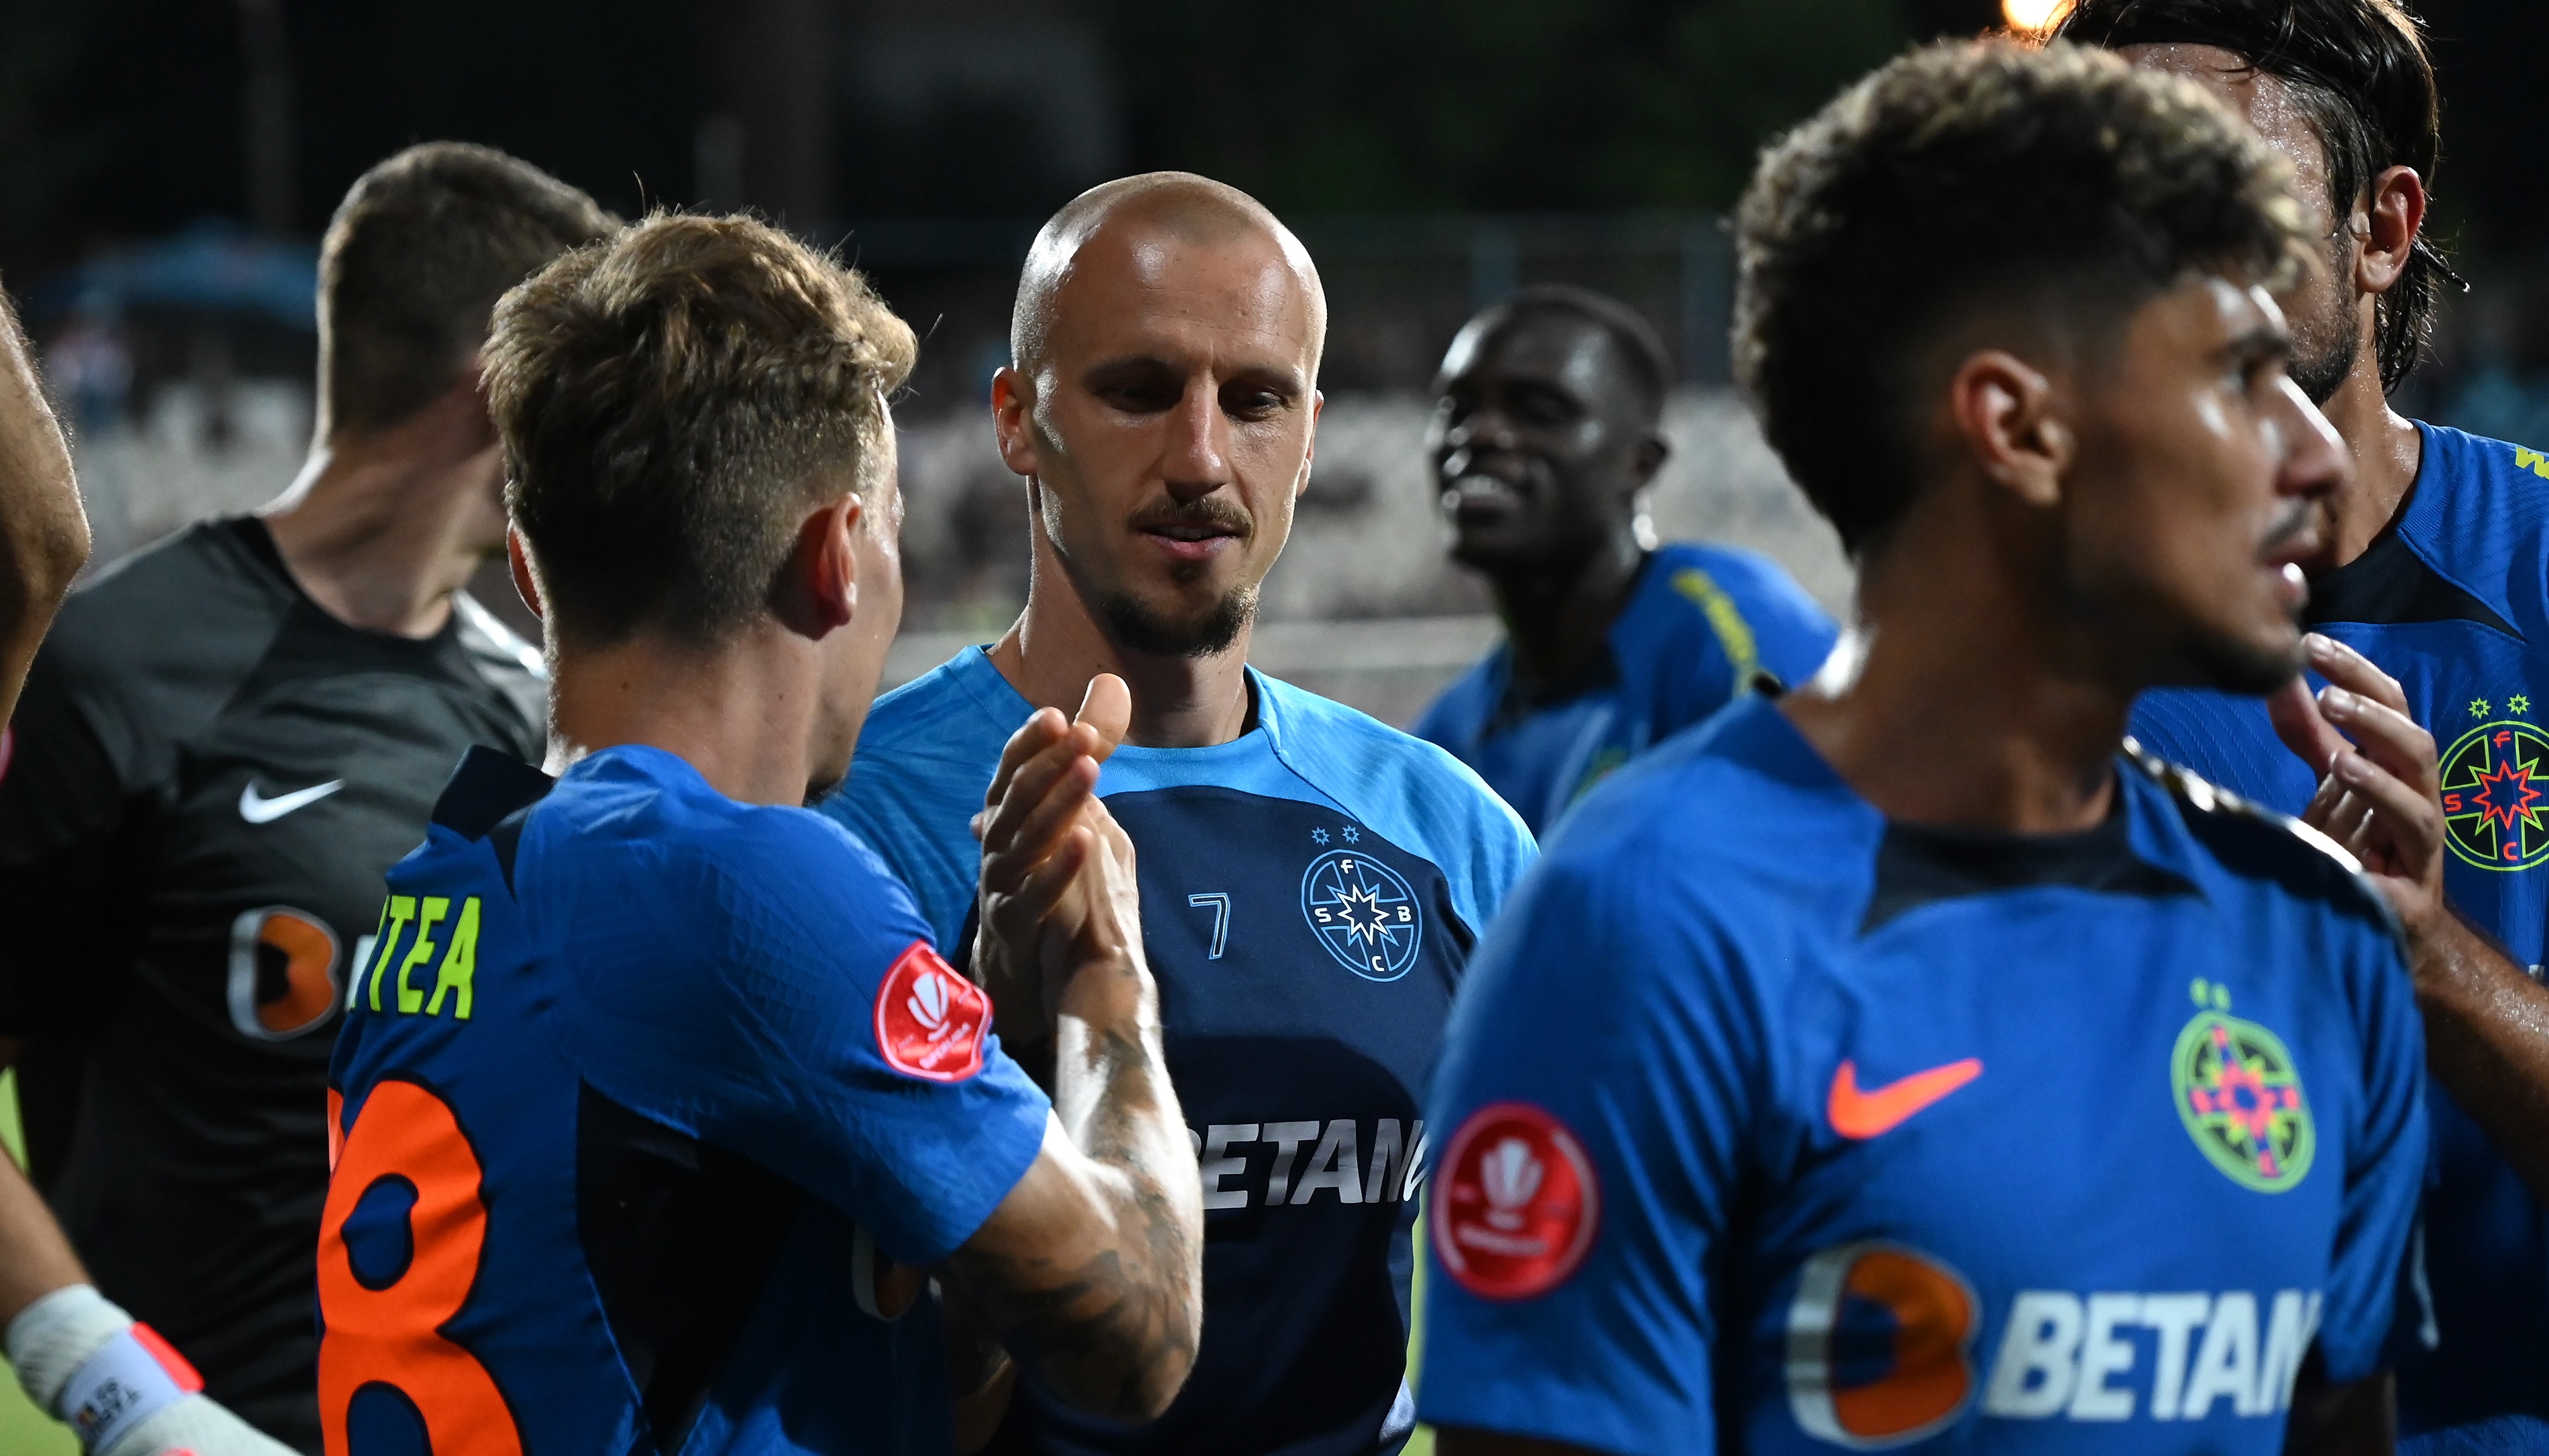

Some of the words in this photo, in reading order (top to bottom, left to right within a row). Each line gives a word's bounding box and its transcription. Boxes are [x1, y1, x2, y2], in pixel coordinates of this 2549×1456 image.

[350, 894, 481, 1020] TEA
[1188, 892, 1231, 960] 7
[1186, 1118, 1431, 1210] ETAN
[316, 1079, 525, 1456] 8
